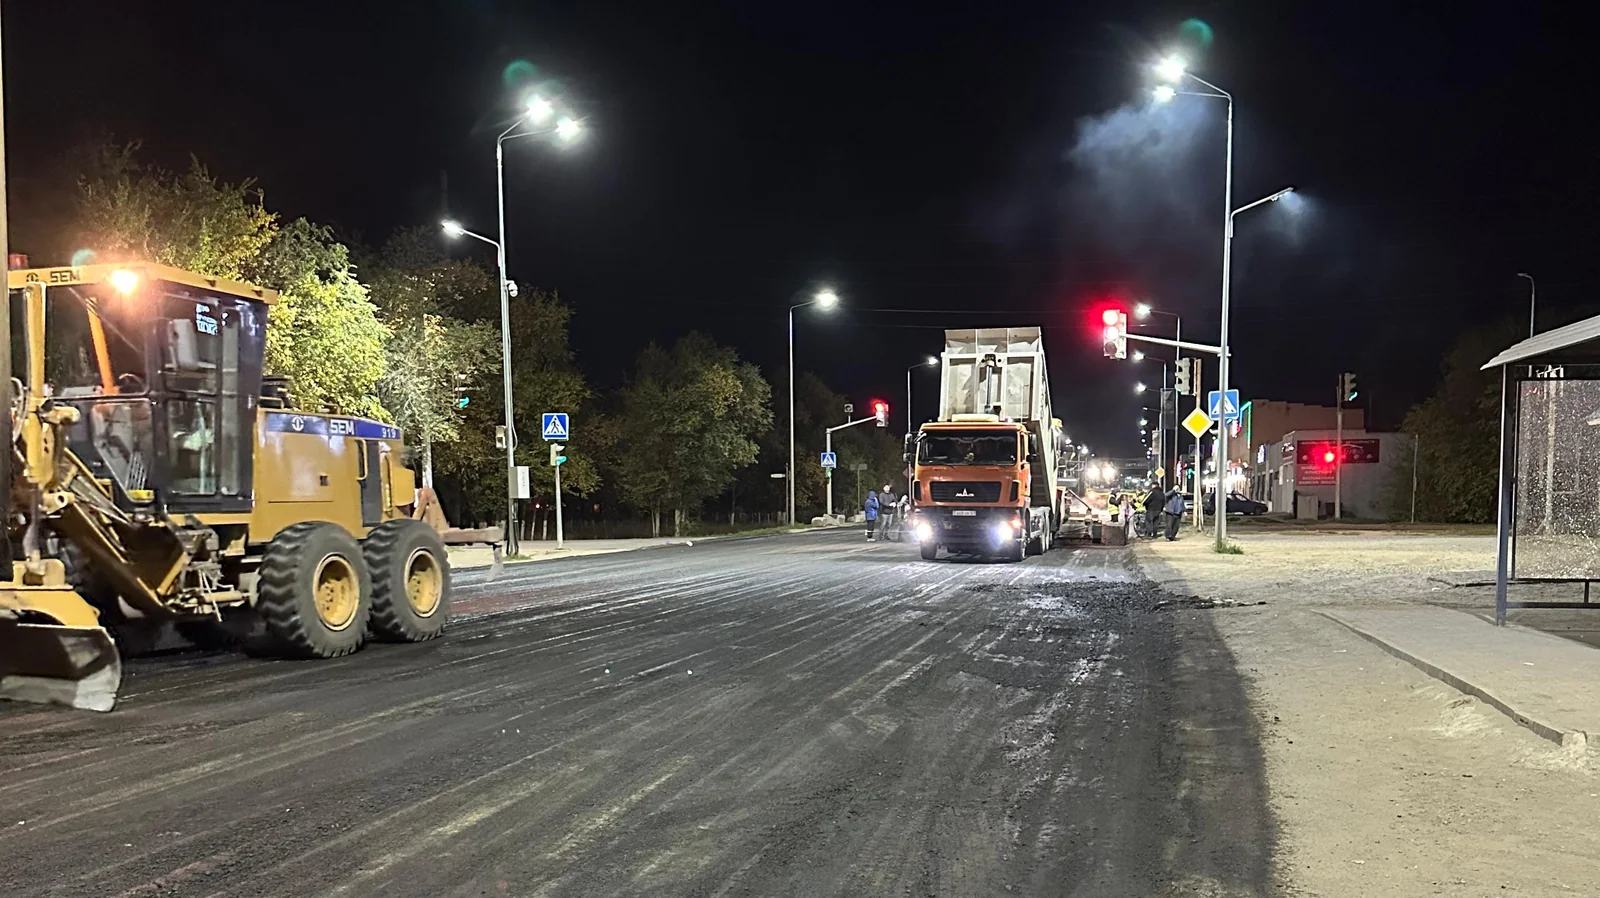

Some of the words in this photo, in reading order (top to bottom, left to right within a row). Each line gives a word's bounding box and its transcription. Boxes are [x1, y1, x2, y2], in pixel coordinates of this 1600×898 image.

[50, 270, 80, 282] SEM
[330, 419, 354, 435] SEM
[381, 428, 396, 438] 919
